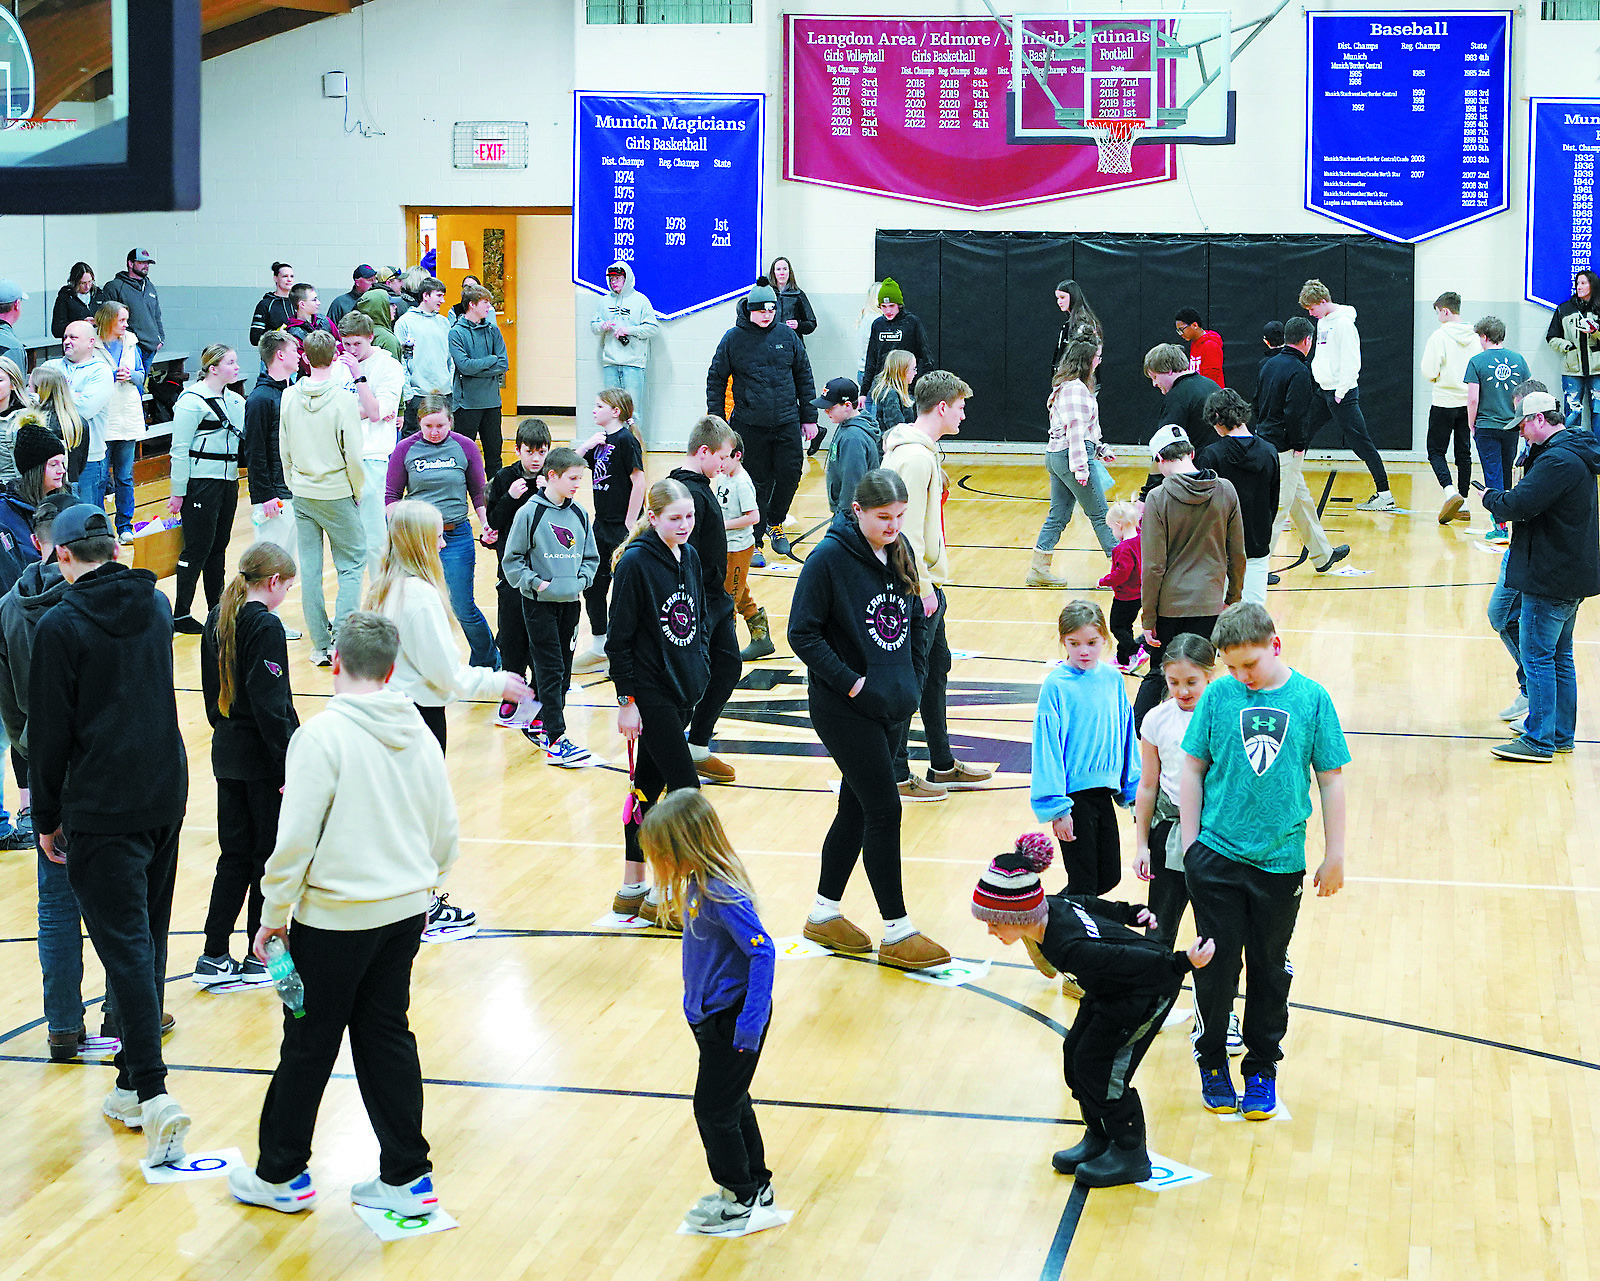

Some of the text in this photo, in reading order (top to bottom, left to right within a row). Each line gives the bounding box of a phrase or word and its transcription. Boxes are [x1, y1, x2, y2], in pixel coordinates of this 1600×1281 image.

[1370, 22, 1448, 35] Baseball
[807, 31, 874, 48] Langdon
[878, 33, 917, 45] Area
[920, 33, 926, 47] /
[930, 32, 990, 45] Edmore
[1004, 31, 1065, 45] ich
[1069, 30, 1150, 44] rdinals
[1354, 42, 1378, 51] Champs
[1401, 42, 1440, 51] Reg. Champs
[824, 49, 884, 65] Girls Volleyball
[912, 49, 975, 62] Girls Basketball
[1100, 47, 1134, 60] Football
[838, 65, 859, 75] Champs
[863, 64, 876, 73] State
[901, 66, 913, 74] Dist.
[914, 66, 934, 77] Champs
[950, 67, 970, 77] Champs
[974, 67, 987, 75] State
[832, 77, 878, 87] 2016 3rd
[906, 79, 988, 88] 2018 2018 5th
[1007, 79, 1026, 89] 21
[1099, 77, 1140, 87] 2017 2nd
[833, 87, 877, 97] 2017 3rd
[906, 89, 989, 98] 2019 2019 5th
[1099, 88, 1136, 97] 2018 1st
[832, 97, 877, 106] 2018 3rd
[905, 99, 988, 108] 2020 2020 1st
[1100, 99, 1135, 107] 2019 1st
[832, 107, 875, 116] 2019 1st
[905, 109, 989, 120] 2021 2021 5th
[1099, 109, 1137, 117] 2020 1st
[595, 114, 745, 133] Munich Magicians
[831, 117, 878, 128] 2020 2nd
[904, 119, 989, 128] 2022 2022 4th
[1565, 114, 1600, 124] Mun
[832, 127, 878, 136] 2021 5th
[626, 136, 707, 151] Girls Basketball
[480, 144, 503, 160] EXIT
[602, 156, 644, 168] Dist. Champs
[659, 158, 699, 169] Reg. Champs
[714, 159, 731, 167] State
[615, 171, 634, 183] 1974
[614, 186, 634, 199] 1975
[614, 202, 634, 214] 1977
[614, 217, 634, 230] 1978
[666, 217, 686, 230] 1978
[715, 218, 728, 231] 1st
[614, 233, 634, 245] 1979
[666, 233, 685, 245] 1979
[712, 233, 731, 246] 2nd
[614, 248, 634, 262] 1982
[414, 457, 456, 472] Cardinals
[662, 624, 697, 646] BASKETBALL
[868, 626, 908, 651] BASKETBALL
